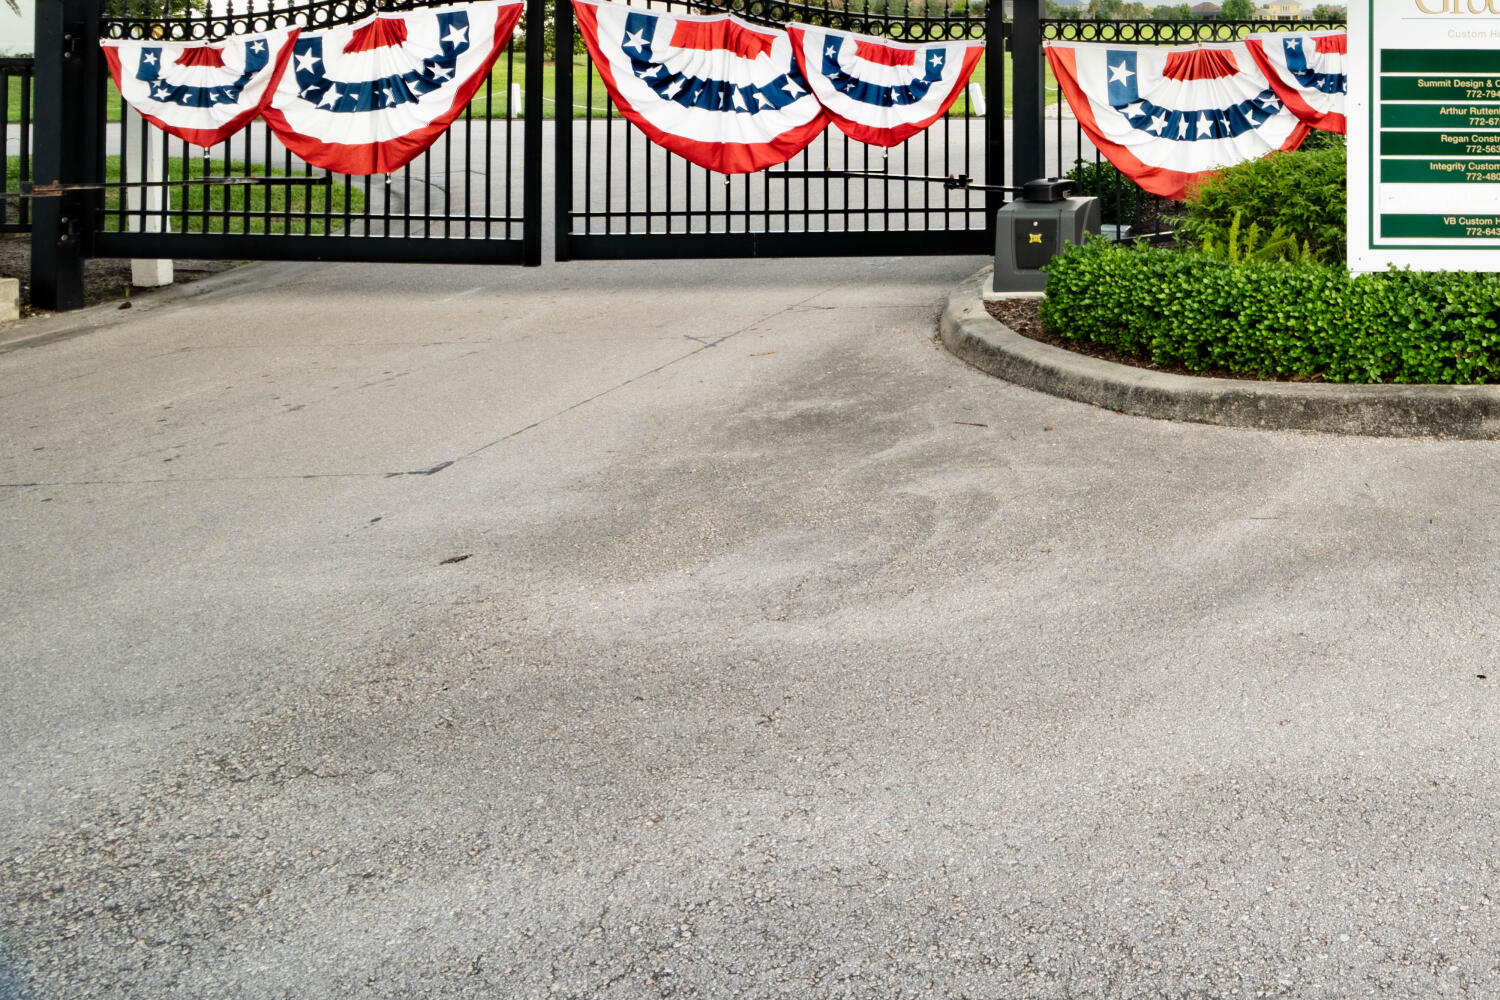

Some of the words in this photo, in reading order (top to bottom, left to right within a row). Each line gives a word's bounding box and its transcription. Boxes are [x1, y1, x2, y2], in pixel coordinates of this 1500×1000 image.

[1448, 30, 1486, 38] Custom
[1418, 79, 1451, 88] Summit
[1454, 79, 1484, 89] Design
[1486, 80, 1493, 88] &
[1440, 106, 1468, 116] Arthur
[1440, 134, 1469, 144] Regan
[1430, 162, 1466, 172] Integrity
[1443, 216, 1457, 225] VB
[1458, 216, 1493, 226] Custom
